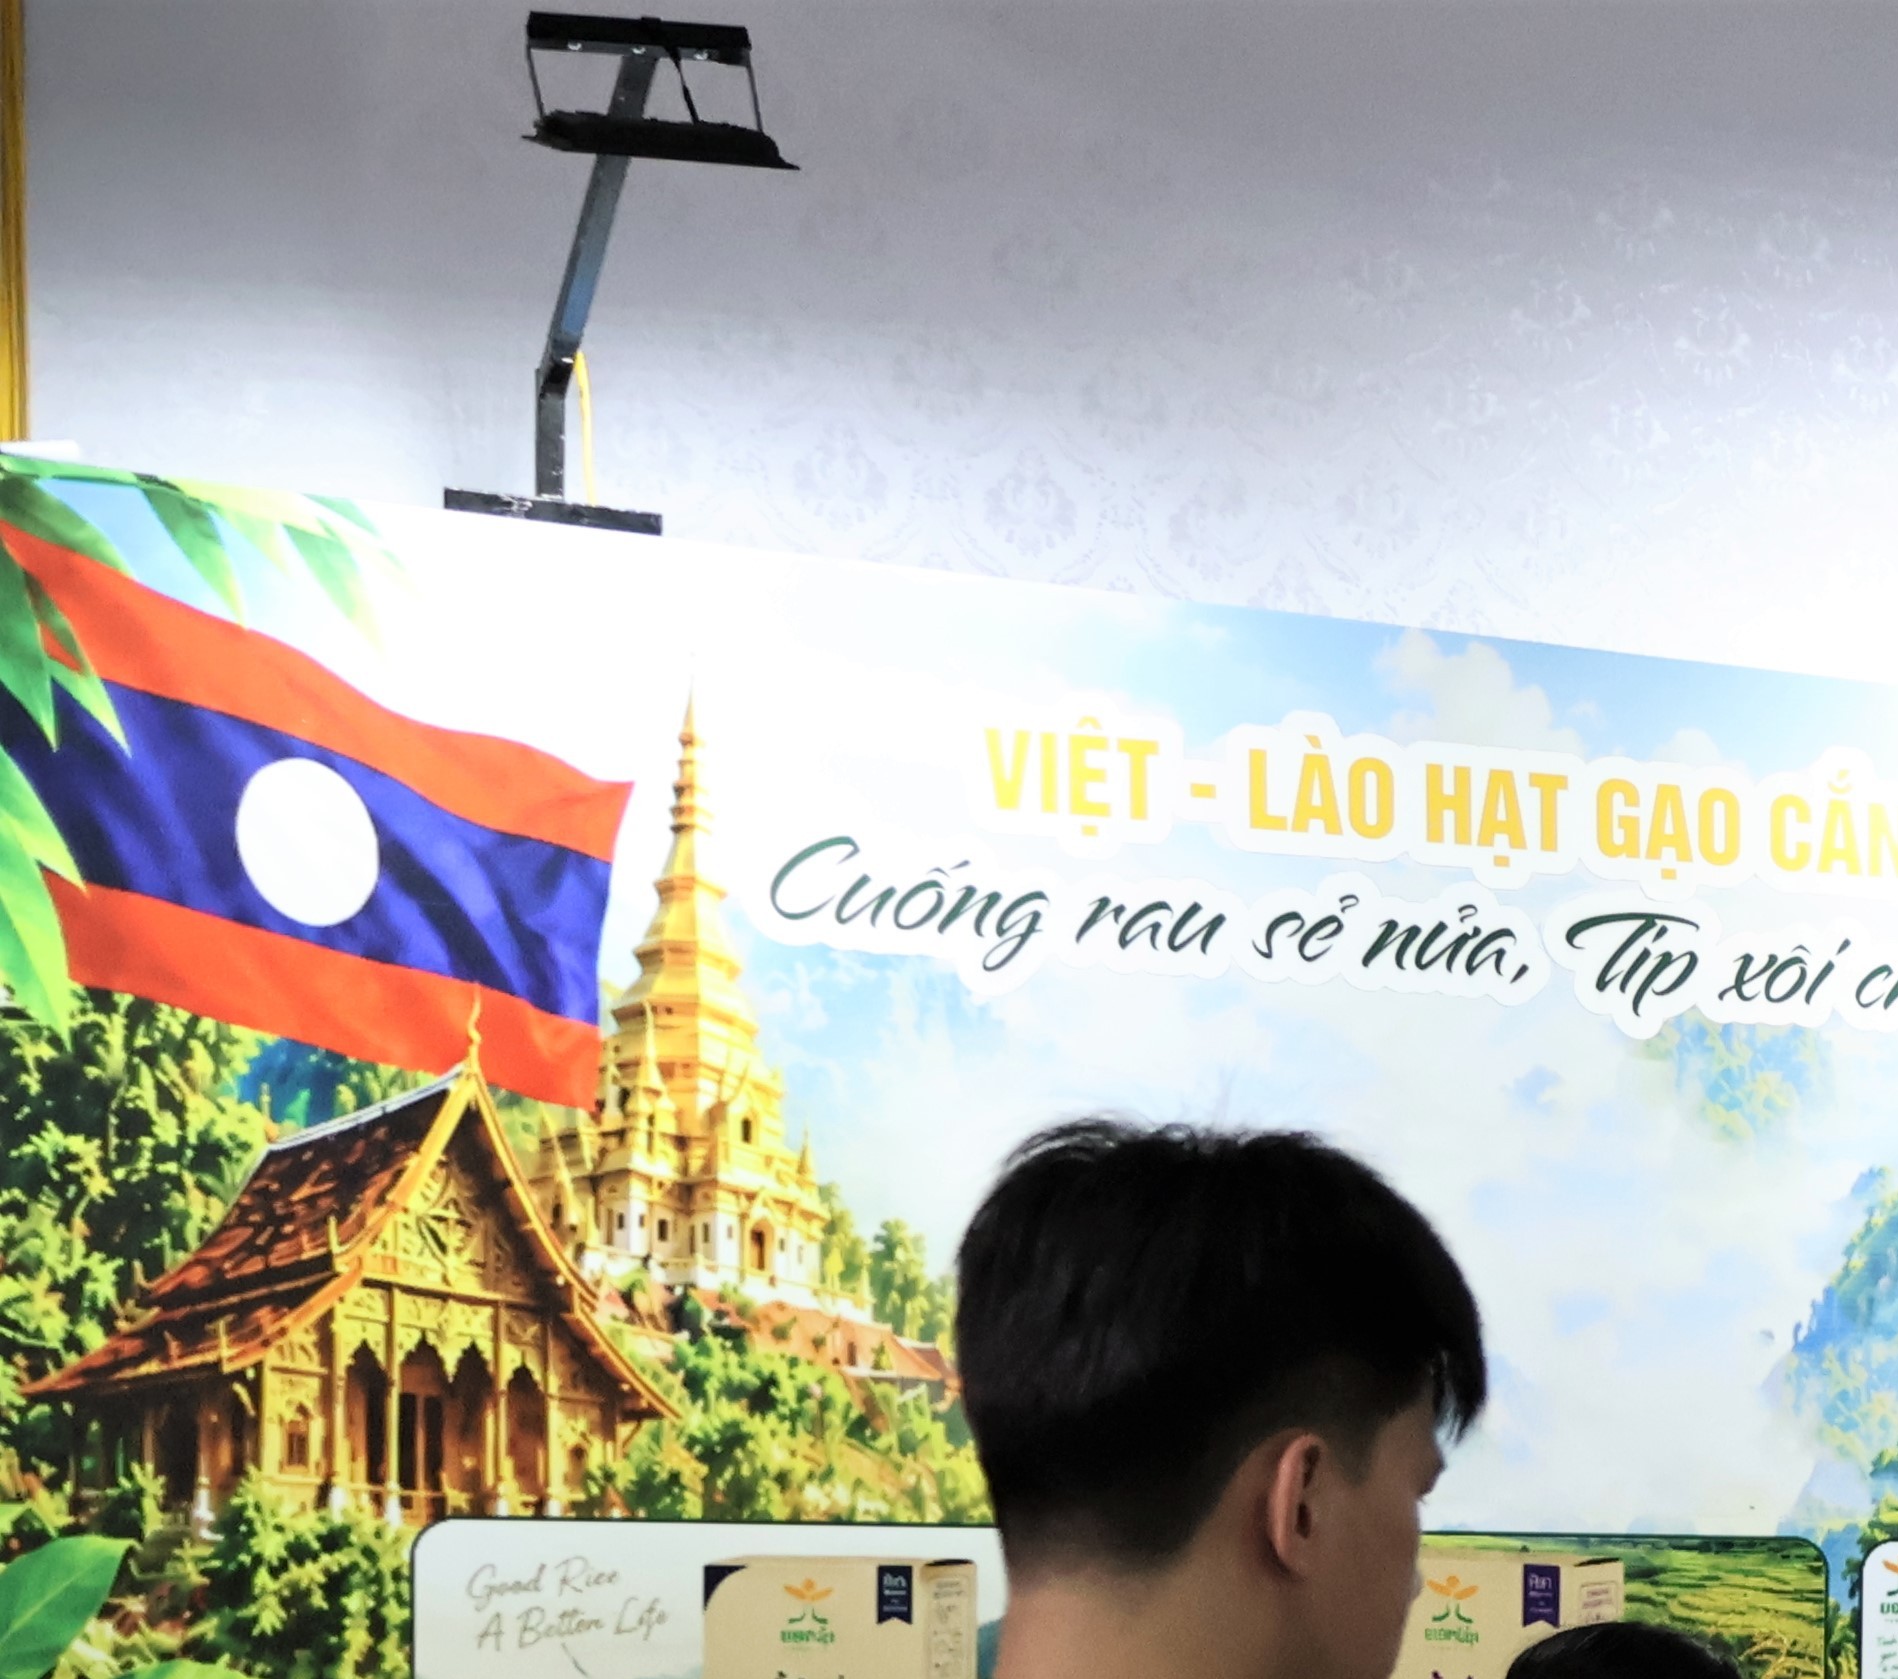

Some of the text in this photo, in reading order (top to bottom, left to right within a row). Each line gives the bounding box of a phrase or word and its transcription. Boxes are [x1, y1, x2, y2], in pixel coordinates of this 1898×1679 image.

[984, 720, 1160, 838] VIỆT
[1249, 735, 1395, 838] LÀO
[1424, 763, 1567, 887] HẠT
[1596, 777, 1741, 880] GẠO
[769, 838, 1046, 972] Cuống
[1073, 896, 1225, 956] rau
[1717, 930, 1835, 1005] xôi
